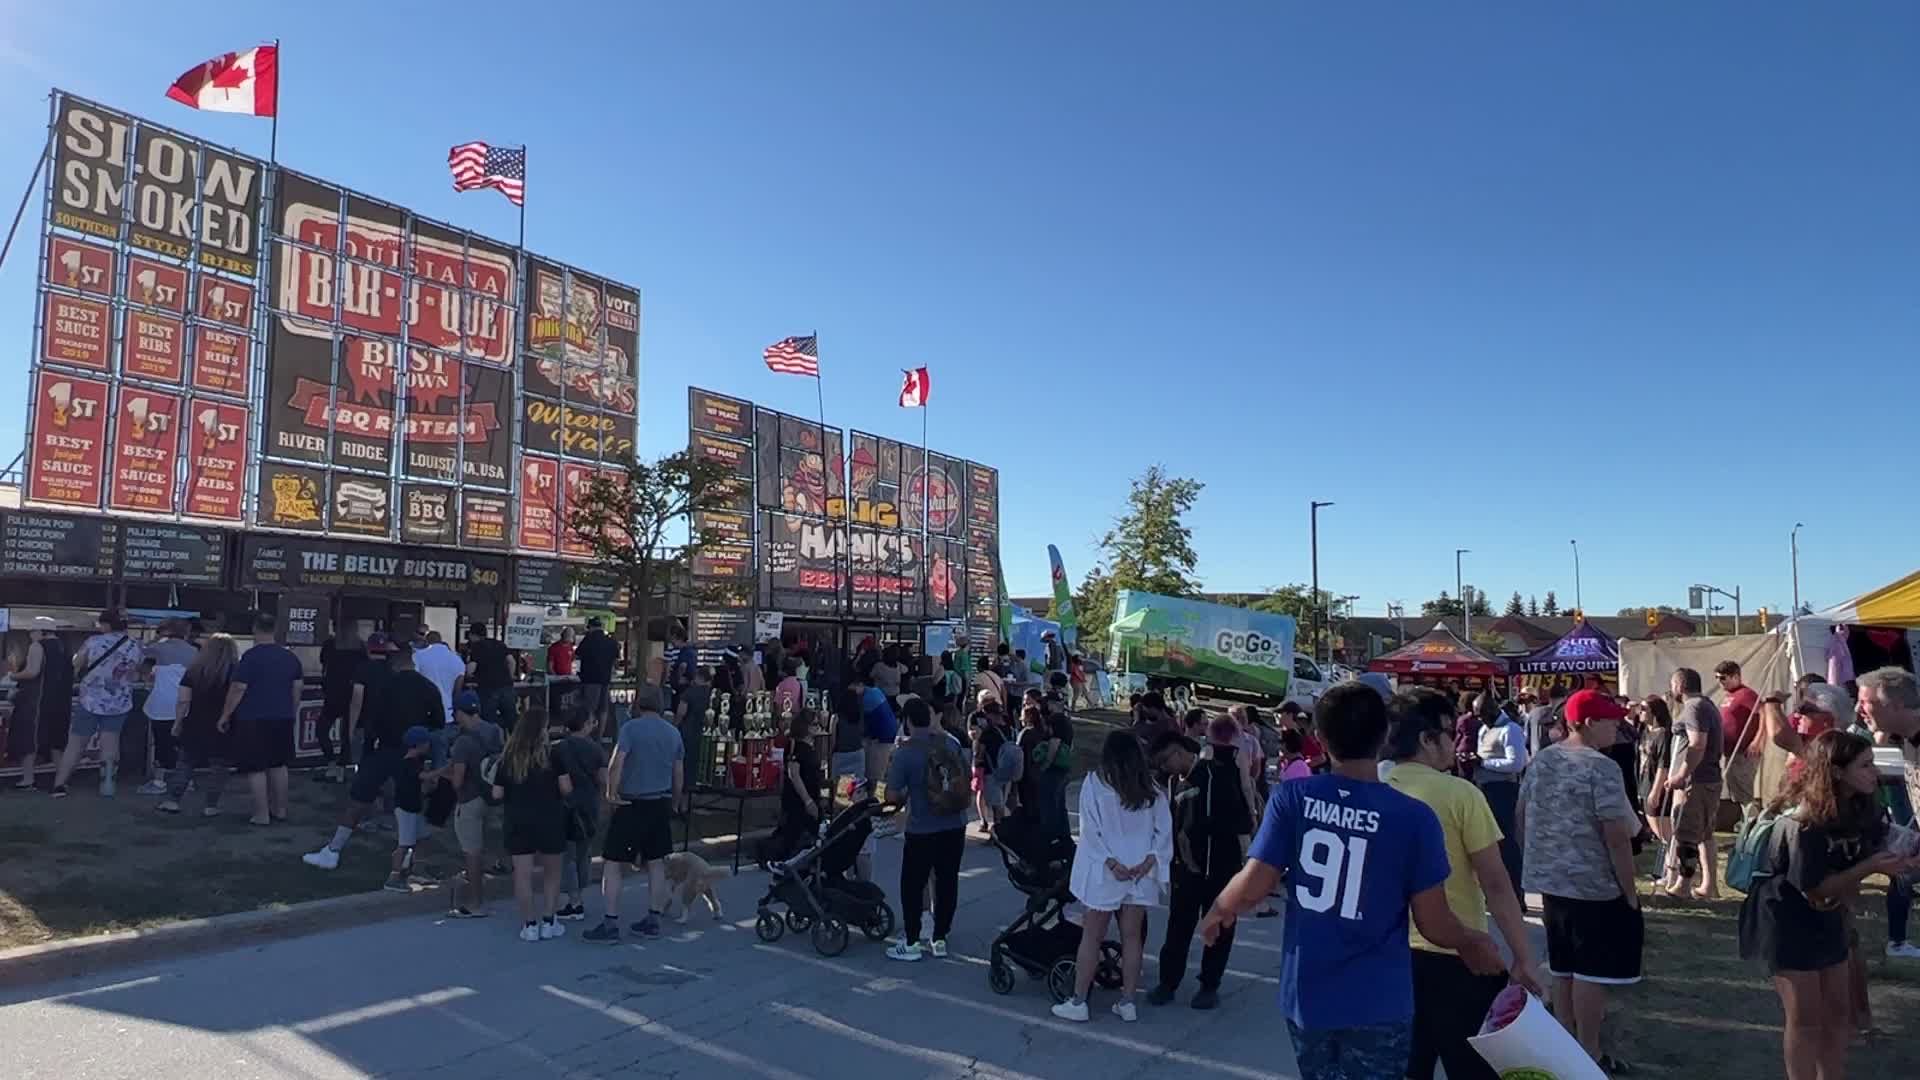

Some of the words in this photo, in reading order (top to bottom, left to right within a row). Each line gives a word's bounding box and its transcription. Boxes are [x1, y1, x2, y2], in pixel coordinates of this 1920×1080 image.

[65, 109, 255, 206] SLOW
[62, 159, 250, 255] SMOKED
[55, 212, 117, 237] SOUTHERN
[132, 233, 188, 259] STYLE
[201, 252, 252, 275] RIBS
[60, 250, 104, 285] 1ST
[136, 270, 177, 302] 1ST
[207, 286, 243, 319] 1ST
[606, 294, 637, 316] VOTE
[58, 304, 100, 323] BEST
[55, 318, 100, 339] SAUCE
[138, 321, 174, 340] BEST
[206, 330, 240, 347] BEST
[138, 336, 171, 355] RIBS
[205, 351, 239, 366] RIBS
[361, 363, 383, 380] IN
[48, 382, 98, 418] 1ST
[127, 397, 171, 432] 1ST
[528, 401, 616, 431] Where
[198, 408, 240, 442] 1ST
[375, 415, 418, 434] RB
[420, 419, 476, 435] TEAM
[46, 434, 93, 450] BEST
[123, 444, 167, 461] BEST
[277, 431, 326, 453] RIVER
[481, 463, 505, 480] USA
[42, 460, 93, 477] SAUCE
[196, 456, 236, 471] BEST
[120, 468, 167, 485] SAUCE
[196, 476, 235, 491] RIBS
[526, 463, 552, 488] 1ST
[408, 502, 447, 520] BBQ
[801, 522, 913, 564] HANK'S
[302, 551, 338, 571] THE
[343, 554, 398, 575] BELLY
[403, 559, 467, 579] BUSTER
[472, 570, 498, 586] $40
[289, 607, 317, 619] BEEF
[515, 615, 536, 625] BEEF
[289, 621, 315, 632] RIBS
[508, 626, 542, 637] BRISKET
[1519, 661, 1550, 672] LITE
[1303, 796, 1380, 833] TAVARES
[1295, 827, 1368, 920] 91
